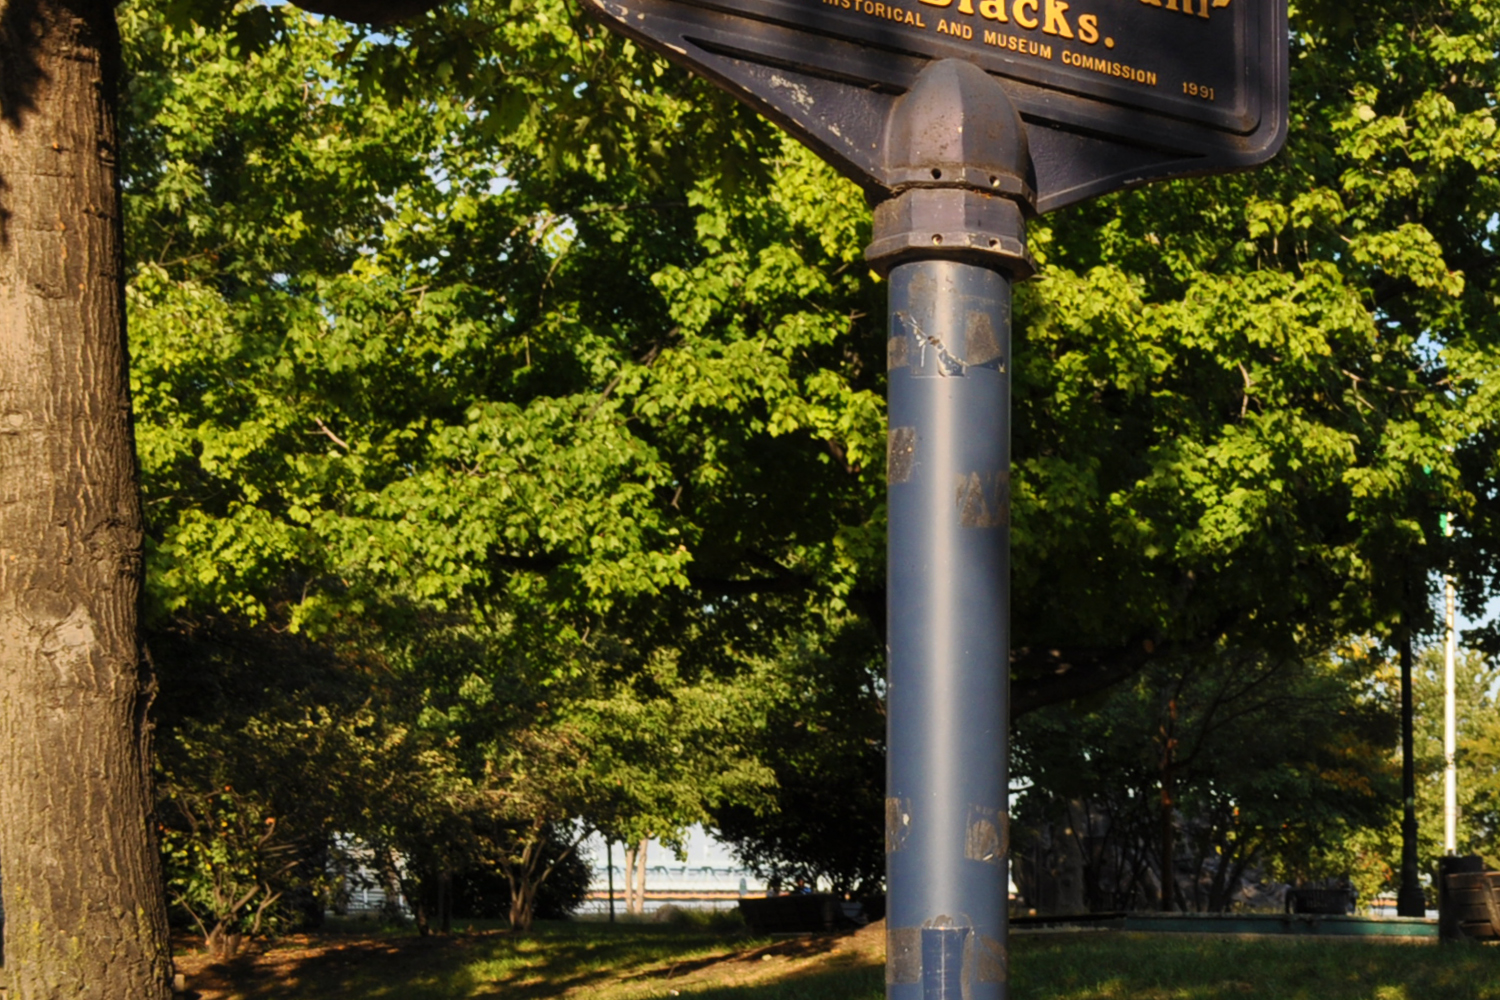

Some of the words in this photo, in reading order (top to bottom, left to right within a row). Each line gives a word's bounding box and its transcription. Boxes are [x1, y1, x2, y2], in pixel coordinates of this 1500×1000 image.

[936, 18, 974, 40] AND
[983, 29, 1053, 60] MUSEUM
[1061, 49, 1157, 86] COMMISSION
[1182, 81, 1215, 101] 1991
